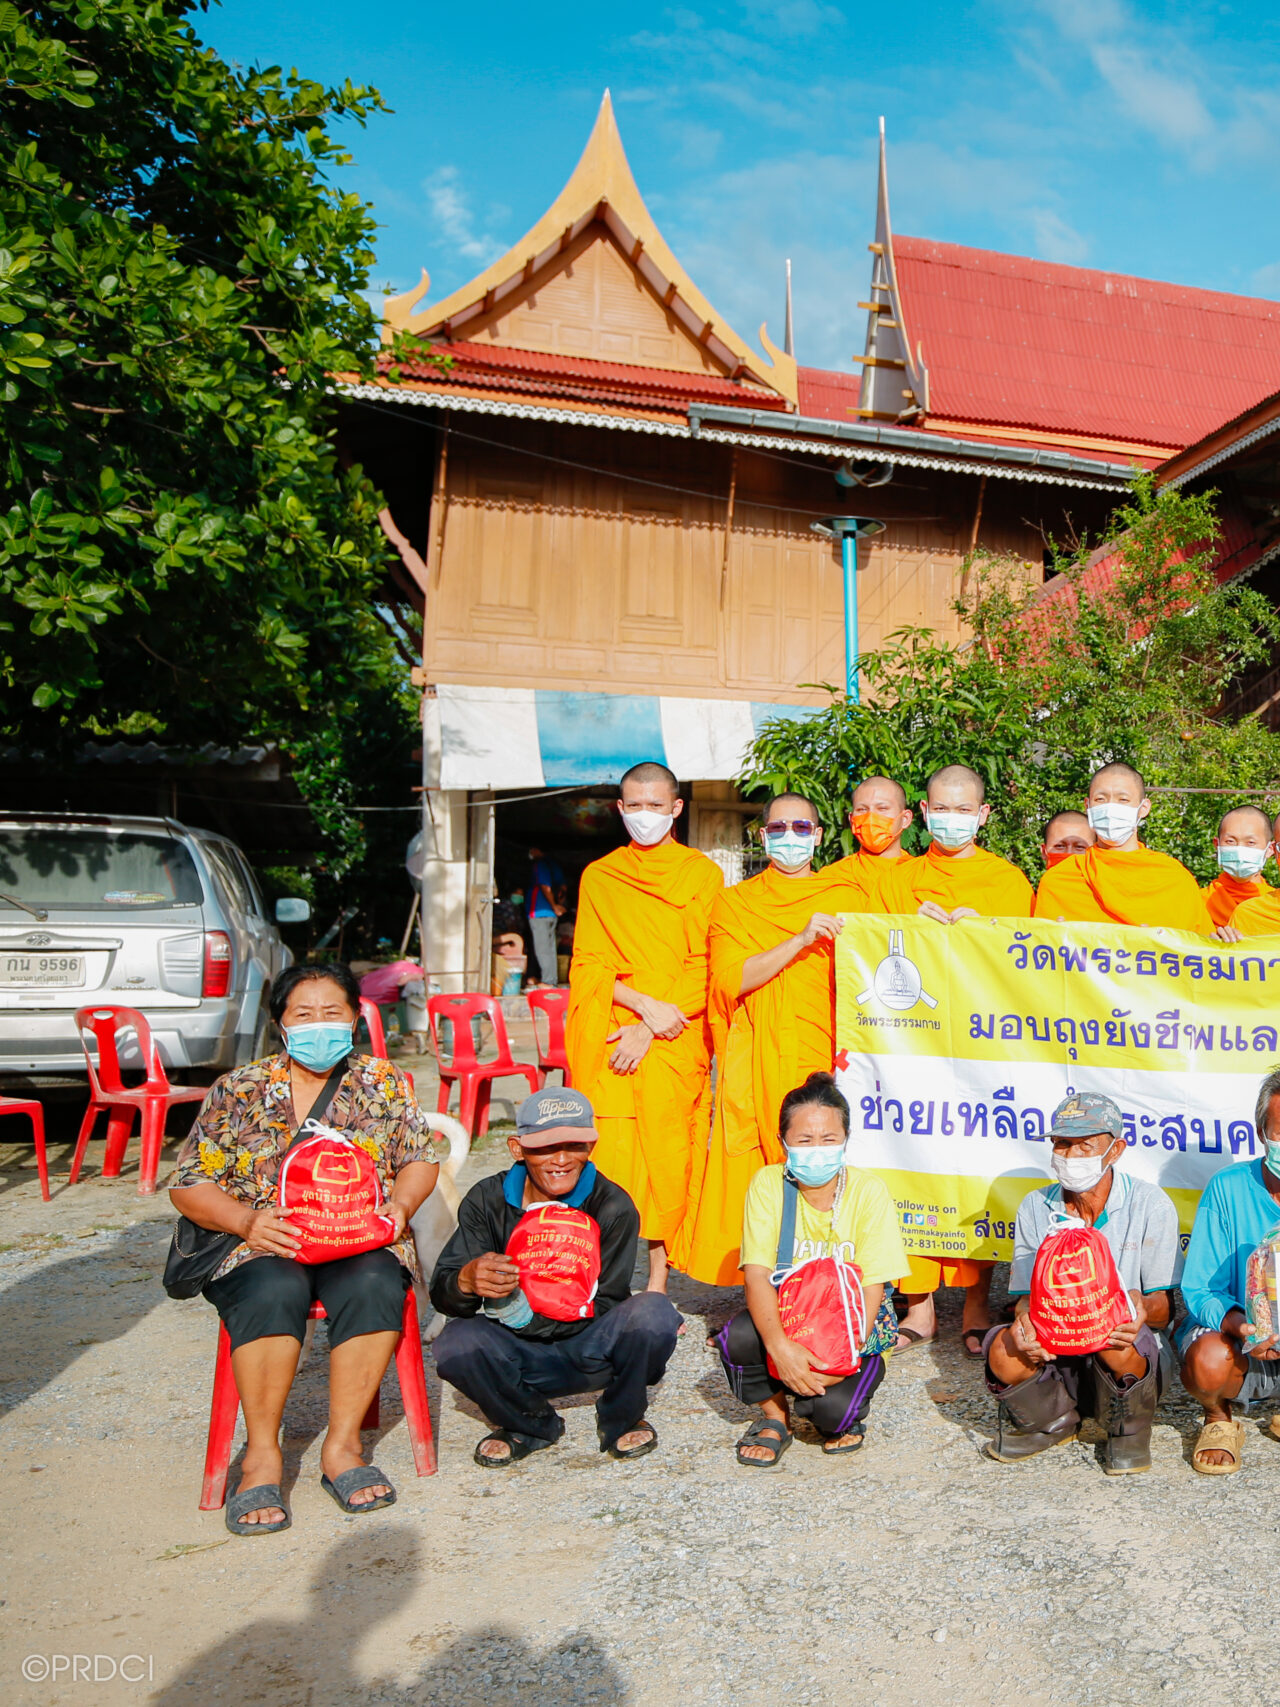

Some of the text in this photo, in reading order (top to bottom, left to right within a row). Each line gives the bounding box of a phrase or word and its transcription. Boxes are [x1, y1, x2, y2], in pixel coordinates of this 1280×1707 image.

[7, 958, 78, 971] กน 9596
[855, 1012, 941, 1030] วัดพระธรรมกาย
[928, 1205, 940, 1213] us
[943, 1205, 957, 1214] on
